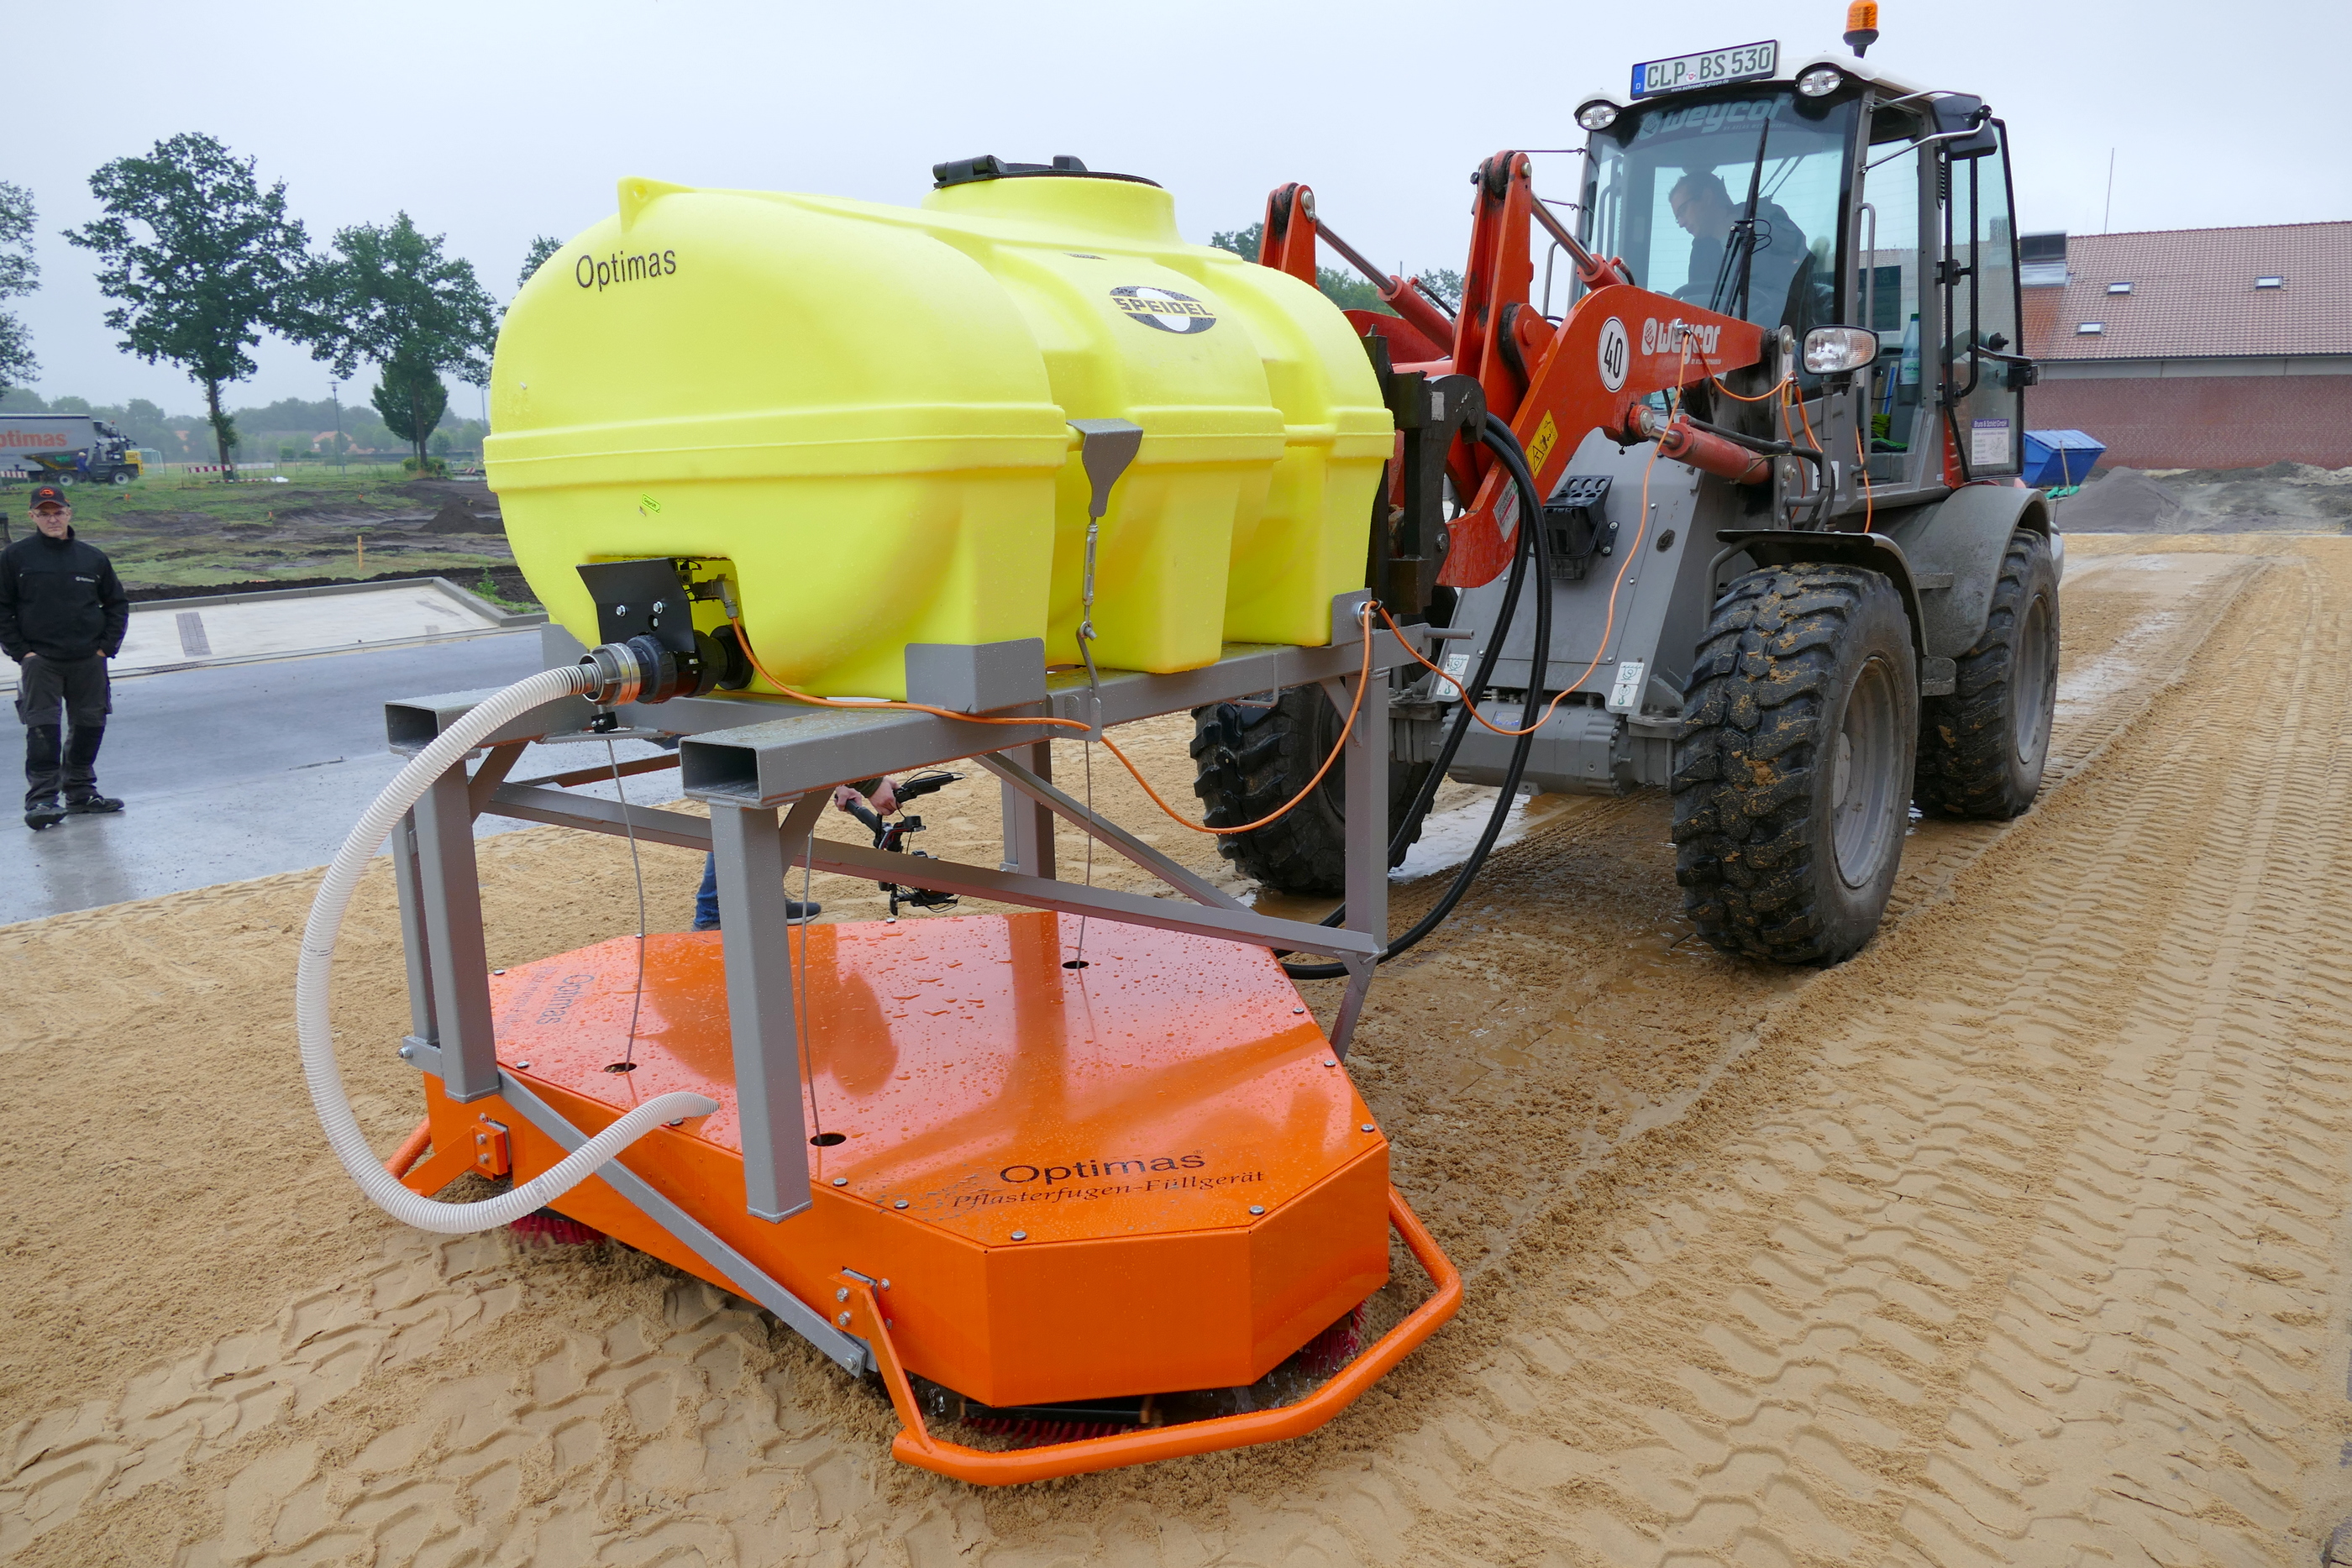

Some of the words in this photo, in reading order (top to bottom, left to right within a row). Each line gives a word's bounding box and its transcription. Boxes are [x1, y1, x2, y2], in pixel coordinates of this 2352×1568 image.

[1646, 61, 1686, 88] CLP
[1699, 54, 1726, 80] BS
[1731, 46, 1771, 75] 530
[1671, 78, 1730, 93] www.schroeder-gruppe.de
[1660, 98, 1789, 134] weycor
[575, 249, 676, 292] Optimas
[1112, 296, 1215, 317] SPEIDEL
[1604, 331, 1623, 379] 40
[536, 974, 596, 1025] Optimas
[1000, 1155, 1205, 1185] Optimas
[952, 1171, 1265, 1210] Pflasterfugen-Füllgerät
